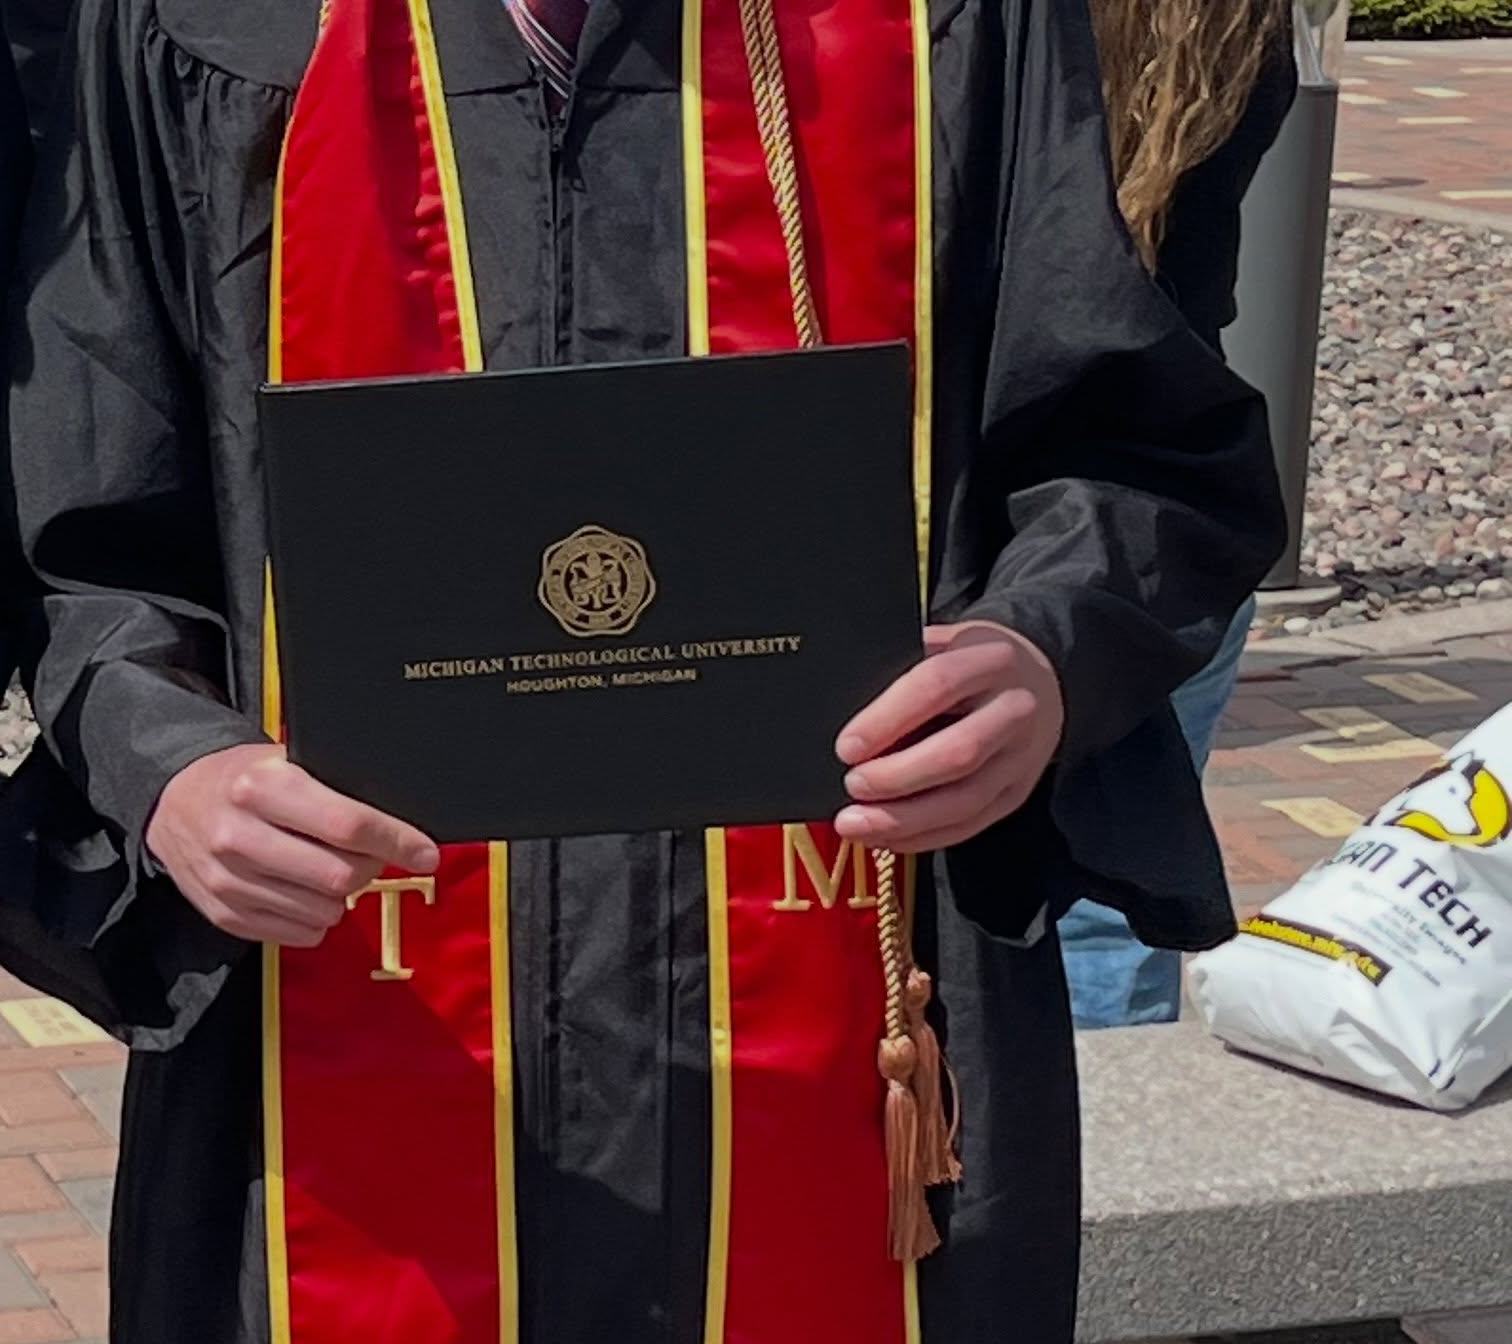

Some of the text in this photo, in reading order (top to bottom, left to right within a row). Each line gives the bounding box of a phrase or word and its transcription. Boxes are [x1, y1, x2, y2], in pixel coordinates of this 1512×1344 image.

[403, 635, 802, 680] MICHIGAN TECHNOLOGICAL UNIVERSITY
[506, 668, 698, 694] HOUGHTON, MICHIGAN
[772, 823, 877, 911] M
[1398, 858, 1493, 949] TECH
[345, 876, 436, 981] T
